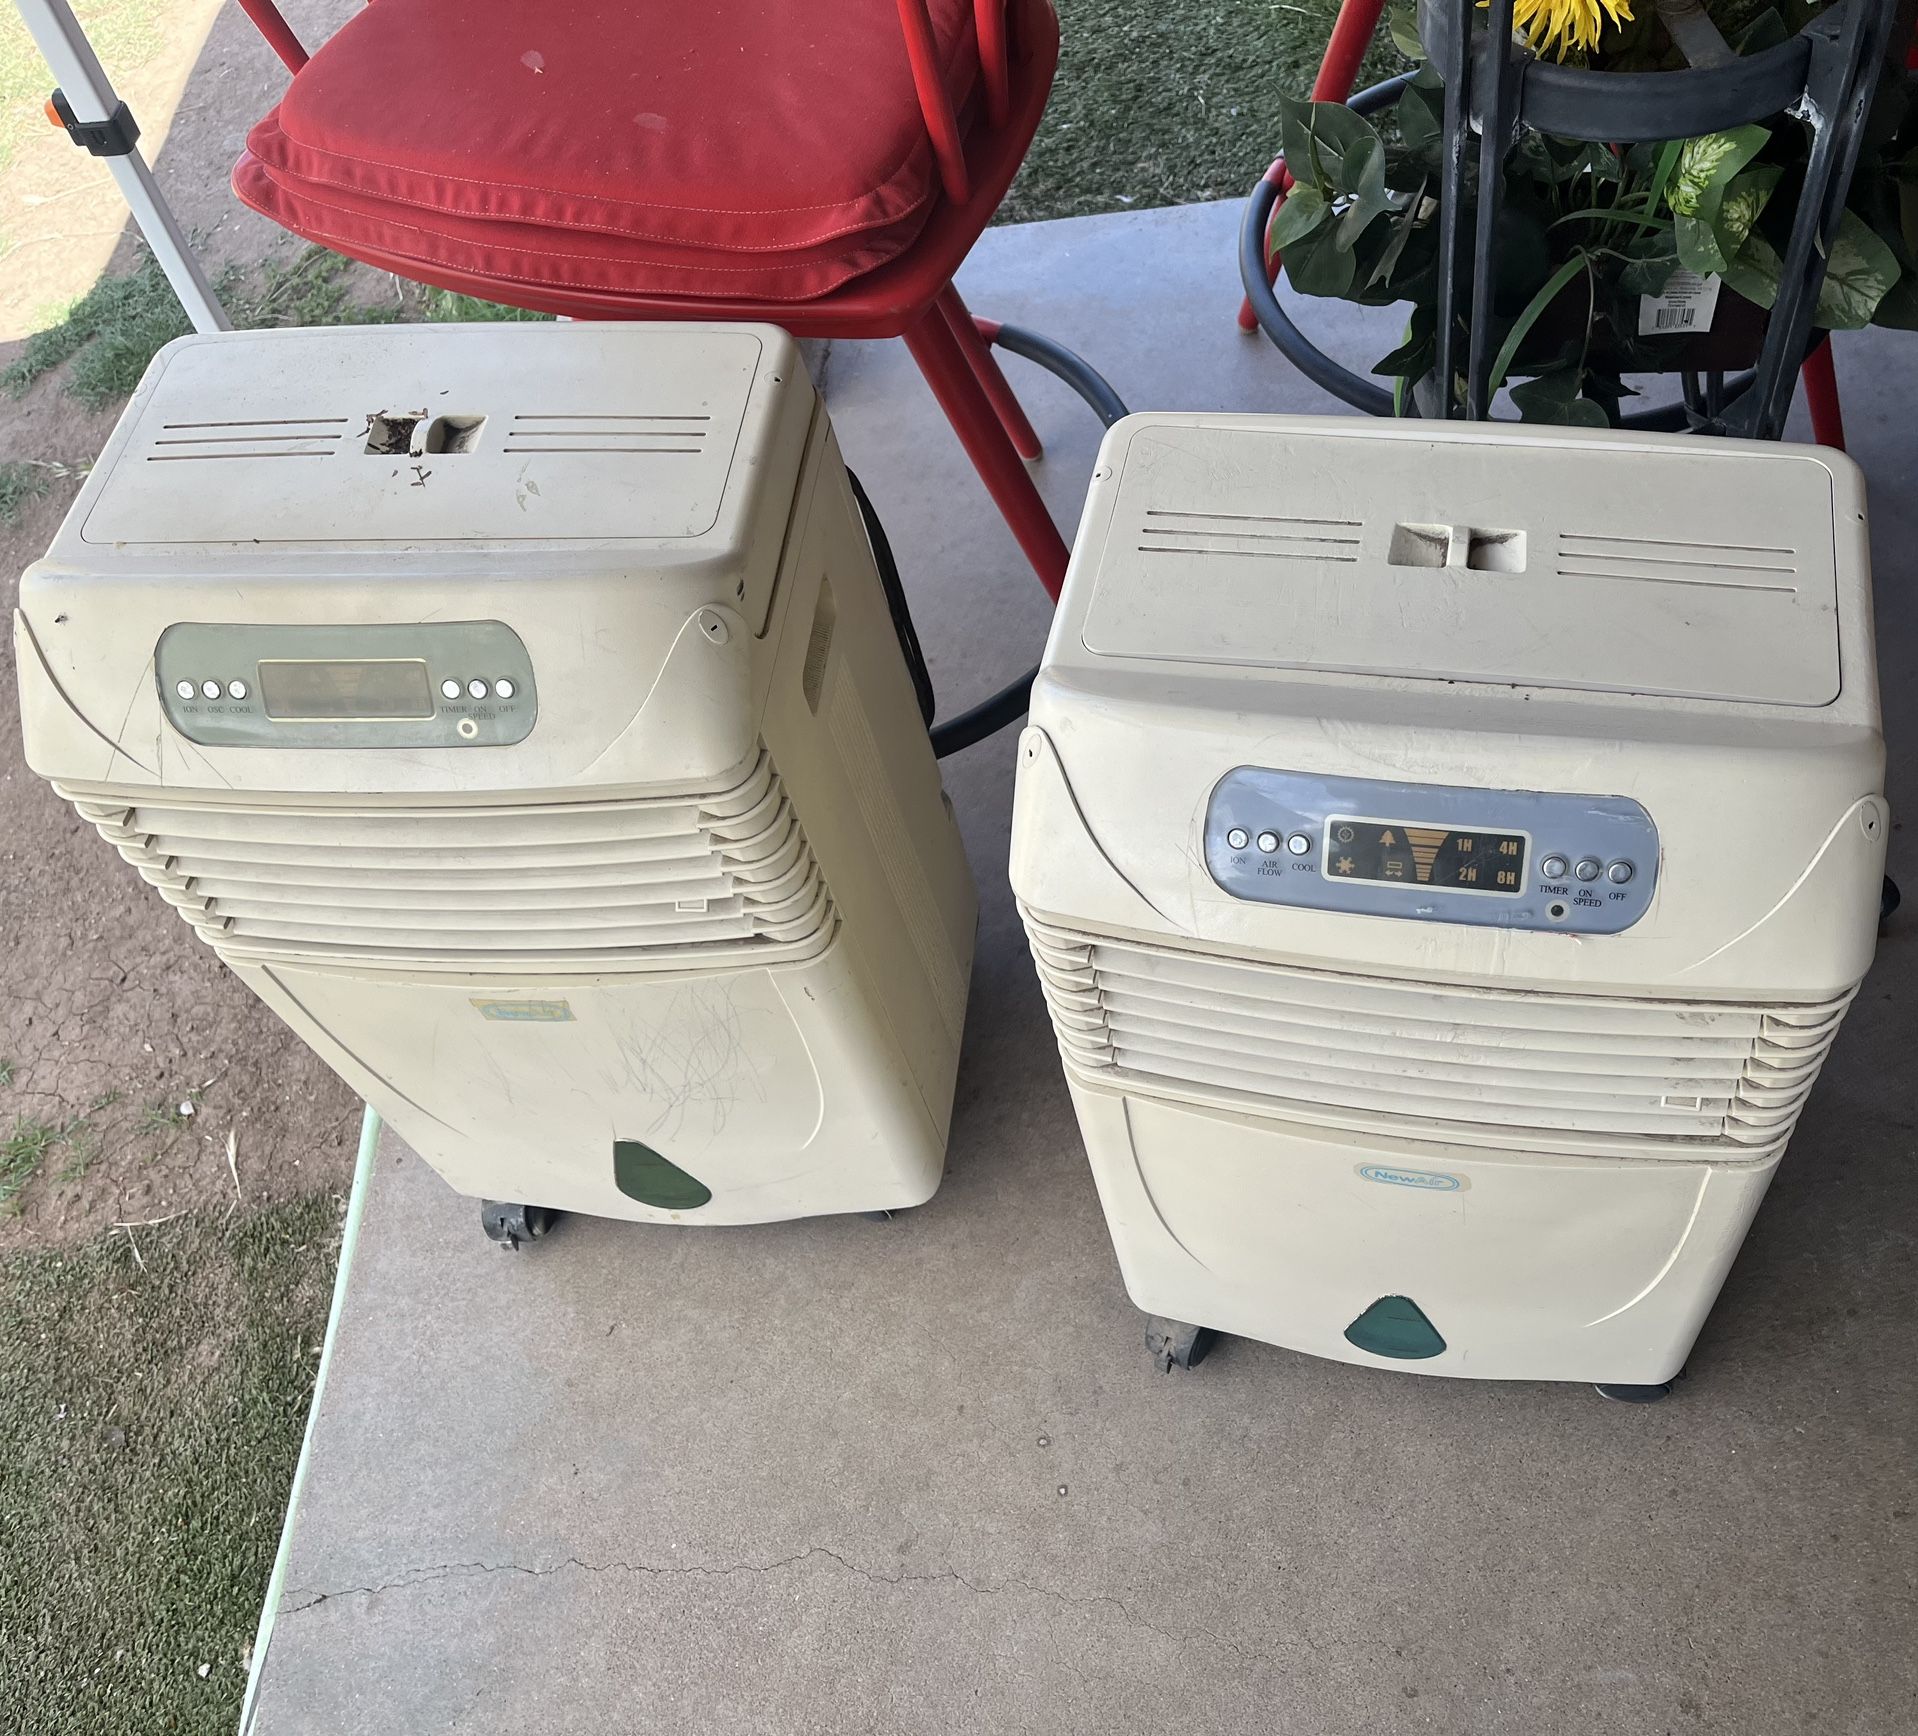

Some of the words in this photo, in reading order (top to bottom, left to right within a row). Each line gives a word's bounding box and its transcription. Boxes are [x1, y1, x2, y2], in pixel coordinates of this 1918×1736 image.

[183, 705, 199, 714] ION
[207, 705, 225, 714] OSC
[229, 704, 254, 714] COOL
[441, 705, 468, 714] TIMER
[474, 705, 488, 713] ON
[498, 705, 517, 713] OFF
[468, 712, 497, 720] SPEED
[1457, 838, 1473, 853] 1H
[1499, 841, 1518, 855] 4H
[1230, 856, 1247, 865] ION
[1261, 860, 1279, 869] AIR
[1257, 867, 1283, 876] FLOW
[1291, 862, 1317, 873] COOL
[1458, 866, 1478, 882] 2H
[1496, 870, 1516, 885] 8H
[1539, 884, 1569, 896] TIMER
[1578, 888, 1593, 898] ON
[1608, 891, 1628, 902] OFF
[1572, 897, 1603, 908] SPEED
[1374, 1170, 1442, 1187] NewAir
